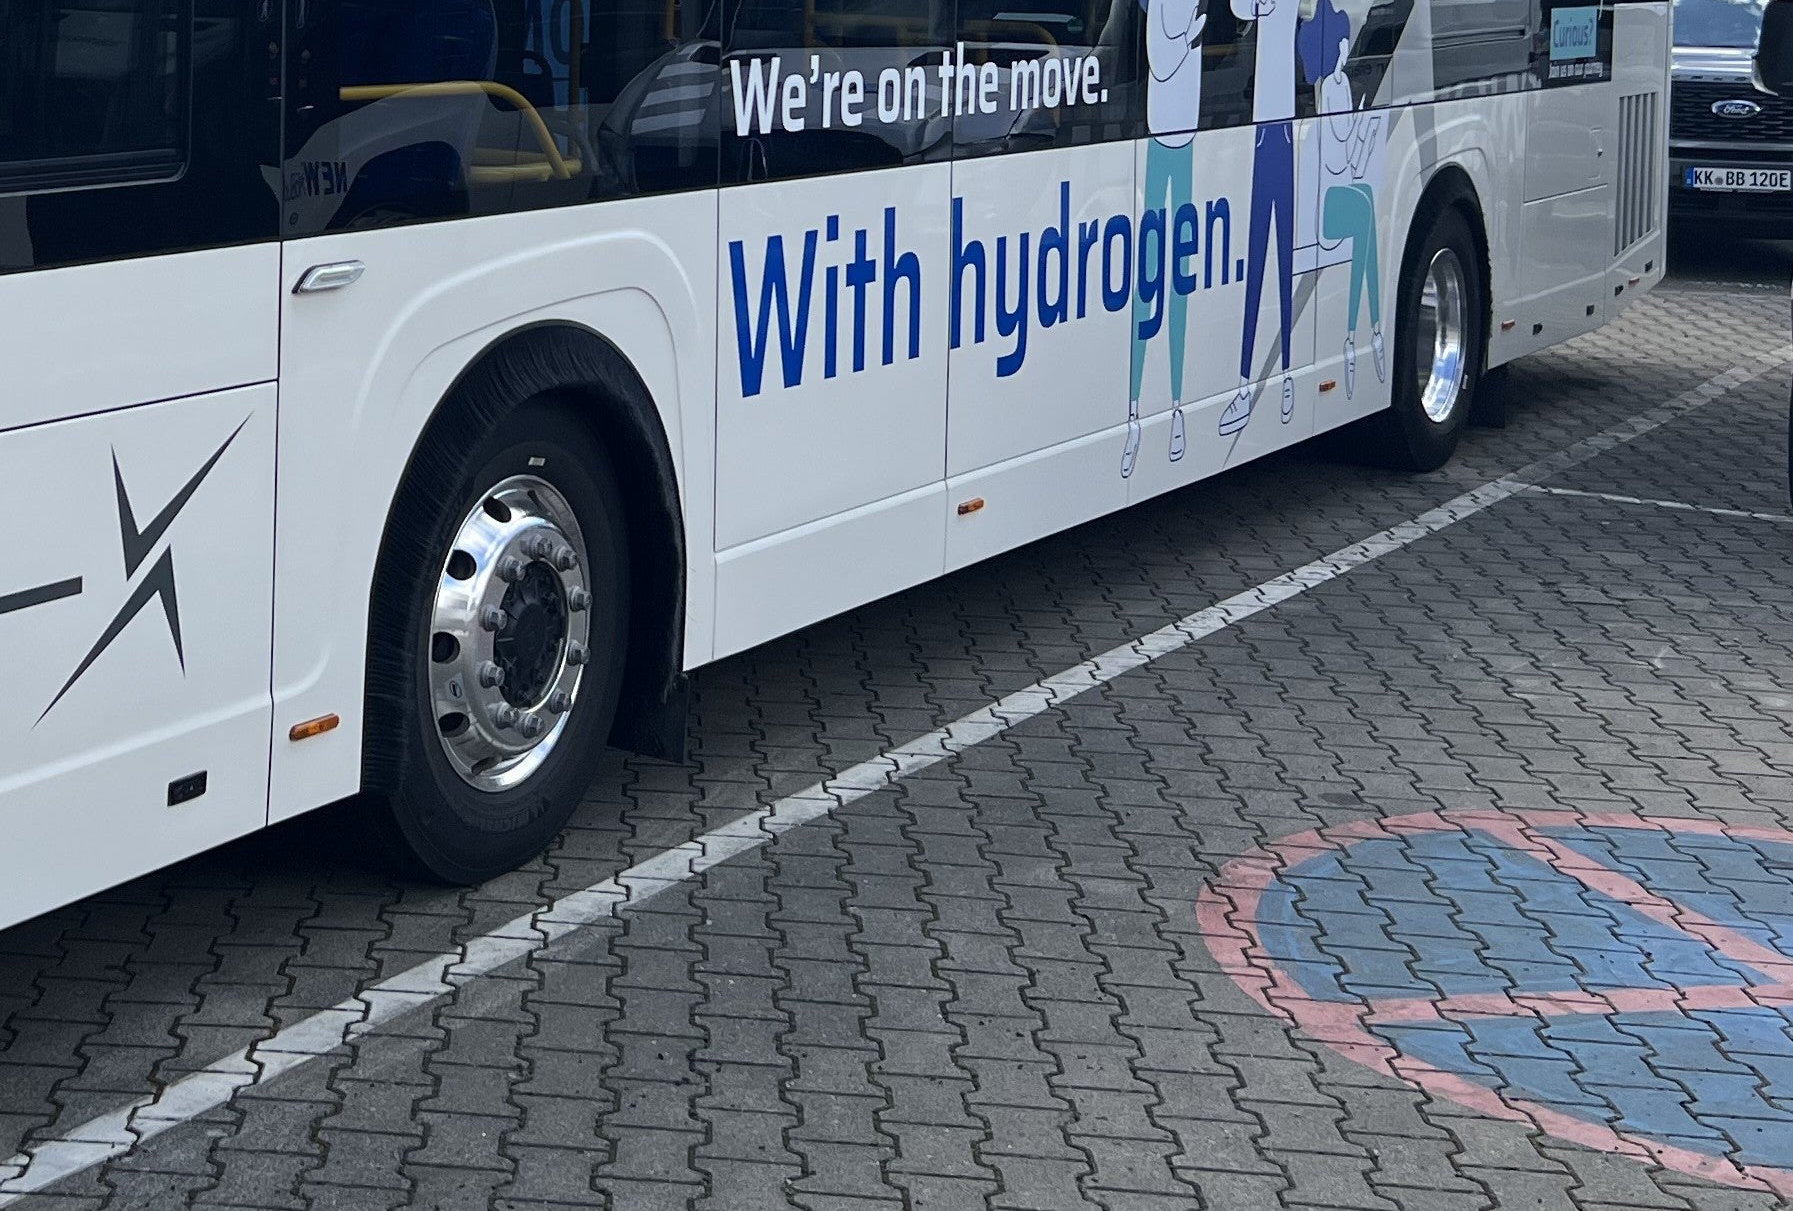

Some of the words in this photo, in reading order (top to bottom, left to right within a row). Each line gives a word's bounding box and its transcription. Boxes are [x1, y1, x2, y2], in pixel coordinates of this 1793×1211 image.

[1553, 16, 1594, 48] Curious?
[729, 55, 865, 137] We're
[877, 64, 928, 125] on
[940, 42, 998, 117] the
[1009, 55, 1109, 111] move.
[1694, 170, 1714, 185] KK
[1726, 171, 1745, 186] BB
[1749, 172, 1789, 188] 120E
[728, 206, 922, 398] With
[949, 180, 1245, 378] hydrogen.
